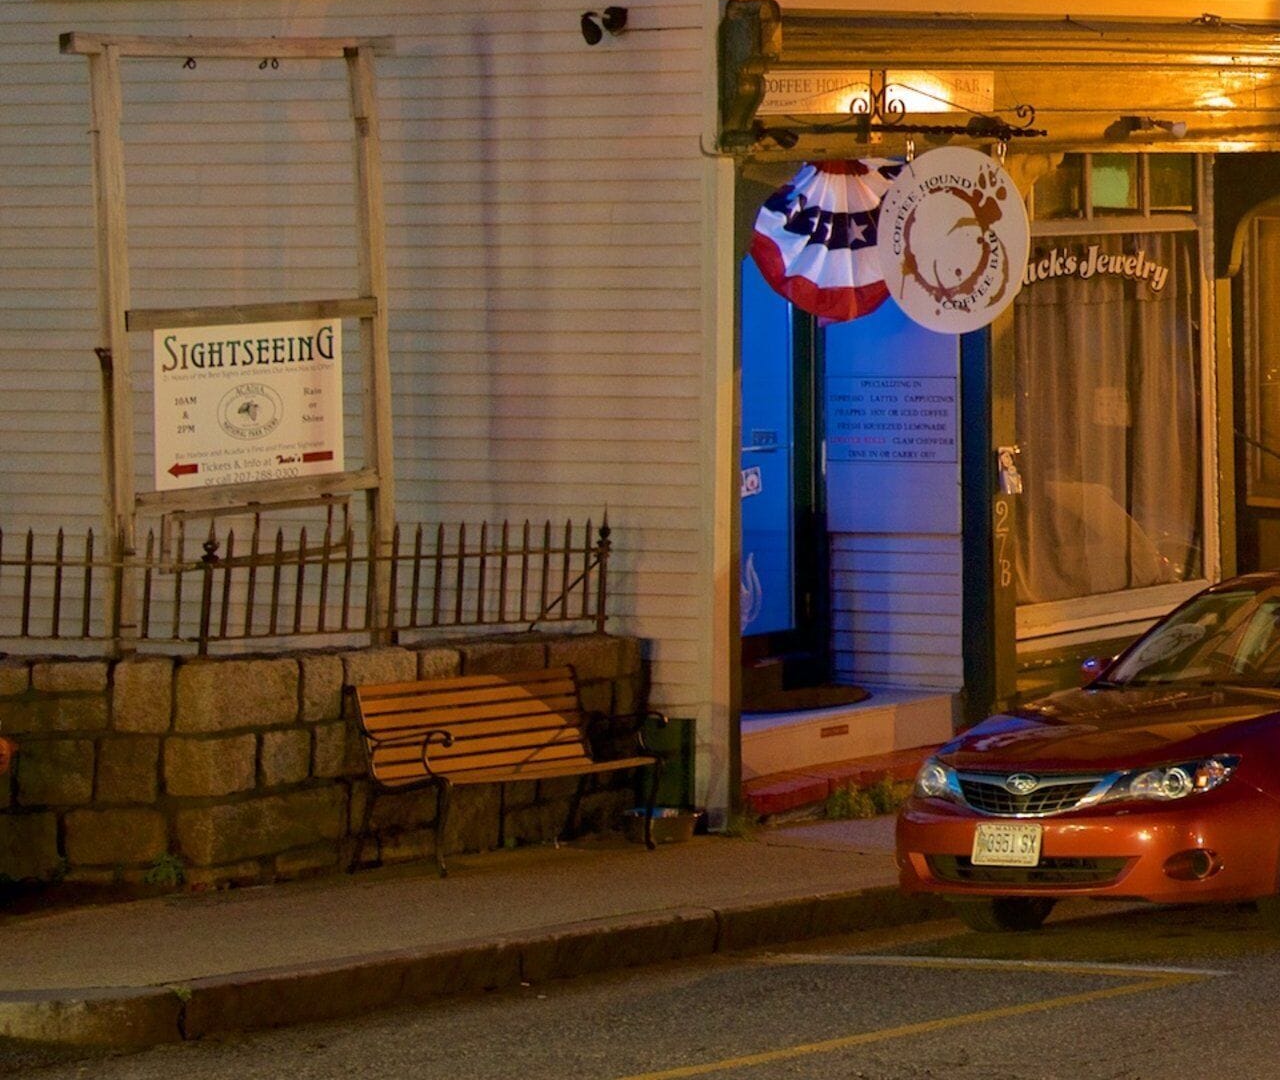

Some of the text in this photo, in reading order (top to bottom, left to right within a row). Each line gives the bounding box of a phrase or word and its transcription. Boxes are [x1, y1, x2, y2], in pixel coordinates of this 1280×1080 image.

[954, 78, 980, 93] BAR
[892, 174, 973, 256] COFFEE HOUND
[941, 229, 1001, 311] COFFEE BAR
[1023, 244, 1169, 291] ack's Jewelry
[162, 326, 335, 373] SIGHTSEEING
[304, 387, 323, 397] Rain
[174, 396, 198, 407] 10AM
[302, 414, 325, 424] Shine
[177, 424, 196, 435] 2PM
[202, 461, 232, 472] Tickets
[233, 460, 241, 469] &
[243, 458, 261, 469] Info
[263, 458, 272, 466] at
[216, 474, 231, 485] call
